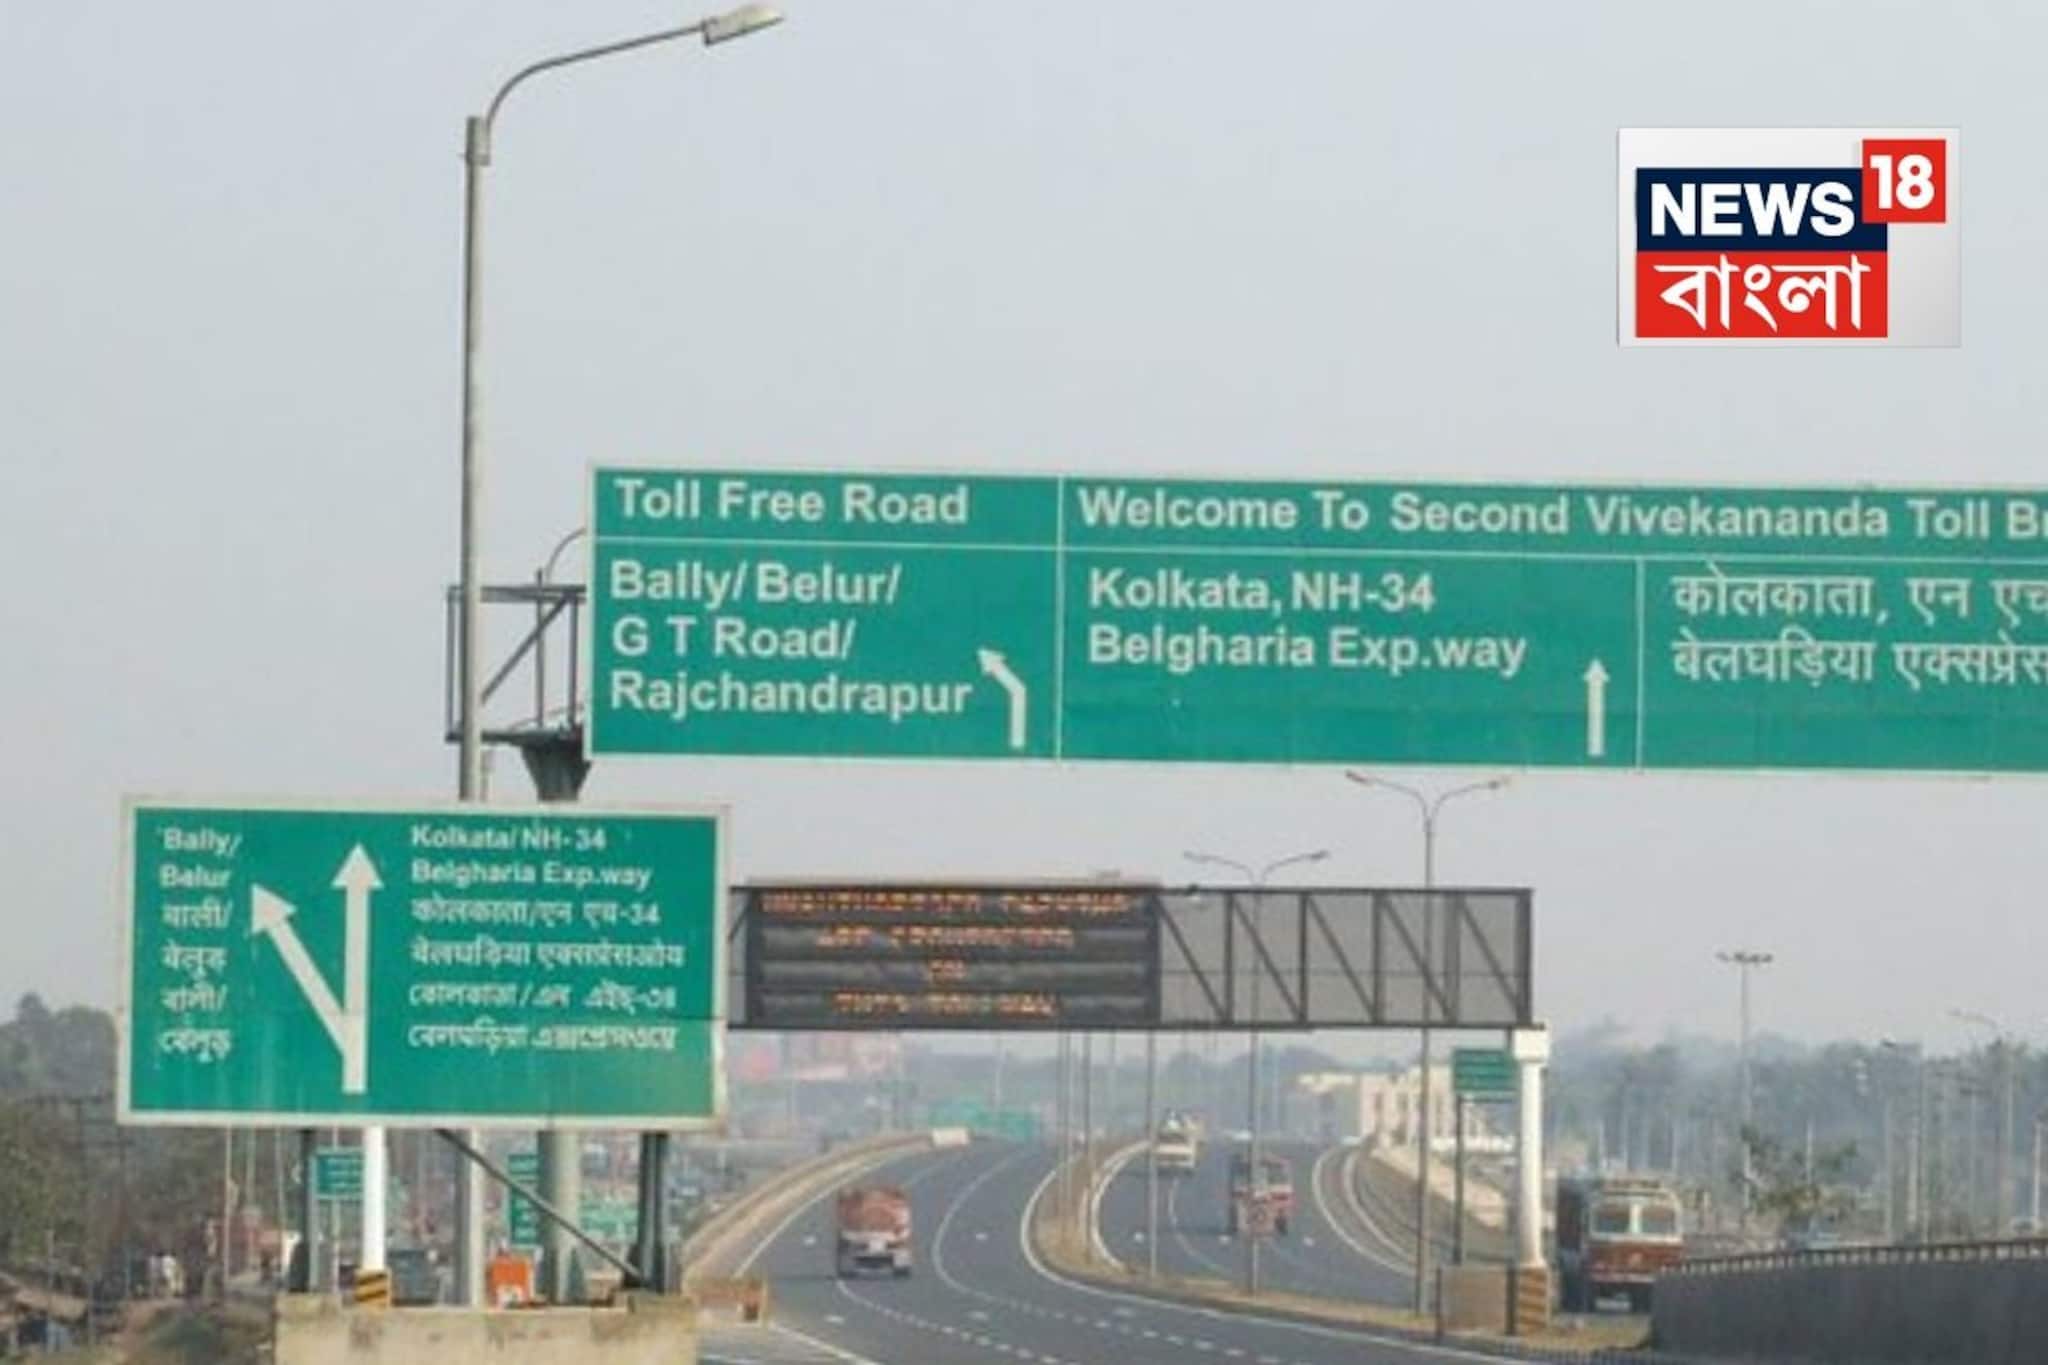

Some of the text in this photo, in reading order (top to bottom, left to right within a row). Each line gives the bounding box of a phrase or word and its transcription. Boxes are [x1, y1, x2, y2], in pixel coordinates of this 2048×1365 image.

[615, 477, 968, 524] Toll Free Road
[1078, 486, 1299, 529] Welcome
[1312, 489, 1370, 531] To
[1390, 491, 1569, 534] Second
[1586, 495, 1889, 537] Vivekananda
[1906, 497, 1990, 539] Toll
[610, 559, 901, 611] Bally/ Belur/
[1089, 567, 1436, 614] Kolkata, NH-34
[1906, 576, 1972, 625] एन
[612, 614, 856, 660] G T Road/
[1089, 623, 1527, 679] Belgharia Exp.way
[610, 669, 974, 723] Rajchandrapur
[411, 858, 651, 892] Belgharia Exp.way
